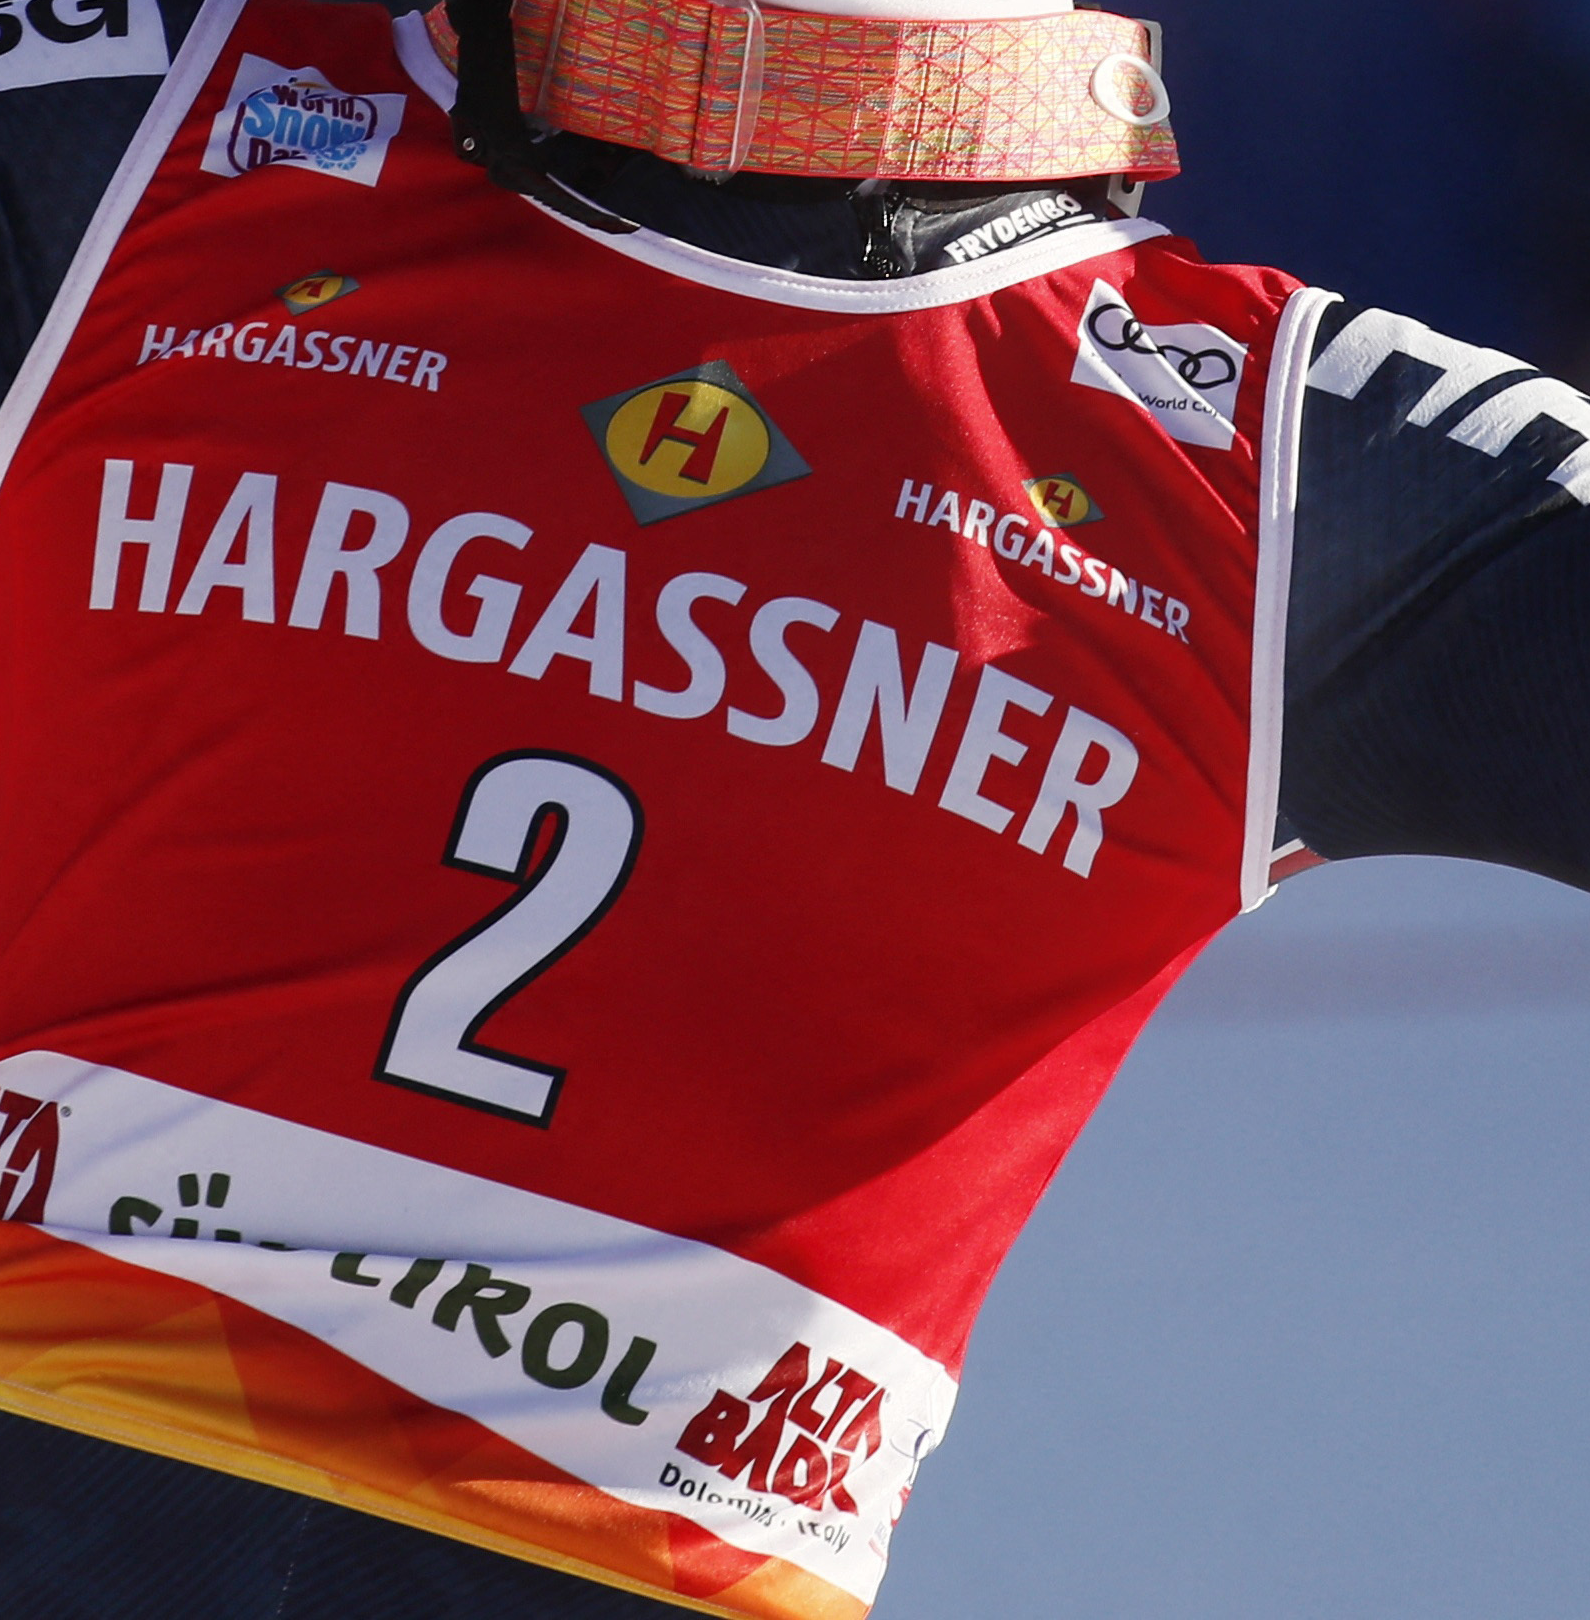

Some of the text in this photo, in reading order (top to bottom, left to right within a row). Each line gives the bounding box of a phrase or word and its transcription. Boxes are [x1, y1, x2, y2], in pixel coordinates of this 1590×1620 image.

[243, 92, 367, 152] Snow
[136, 321, 449, 393] HARGASSNER
[1137, 392, 1188, 412] World
[638, 390, 730, 486] H
[894, 478, 1191, 645] HARGASSNER
[89, 458, 1141, 880] HARGASSNER
[371, 747, 645, 1130] 2
[745, 1340, 887, 1462] ALTA
